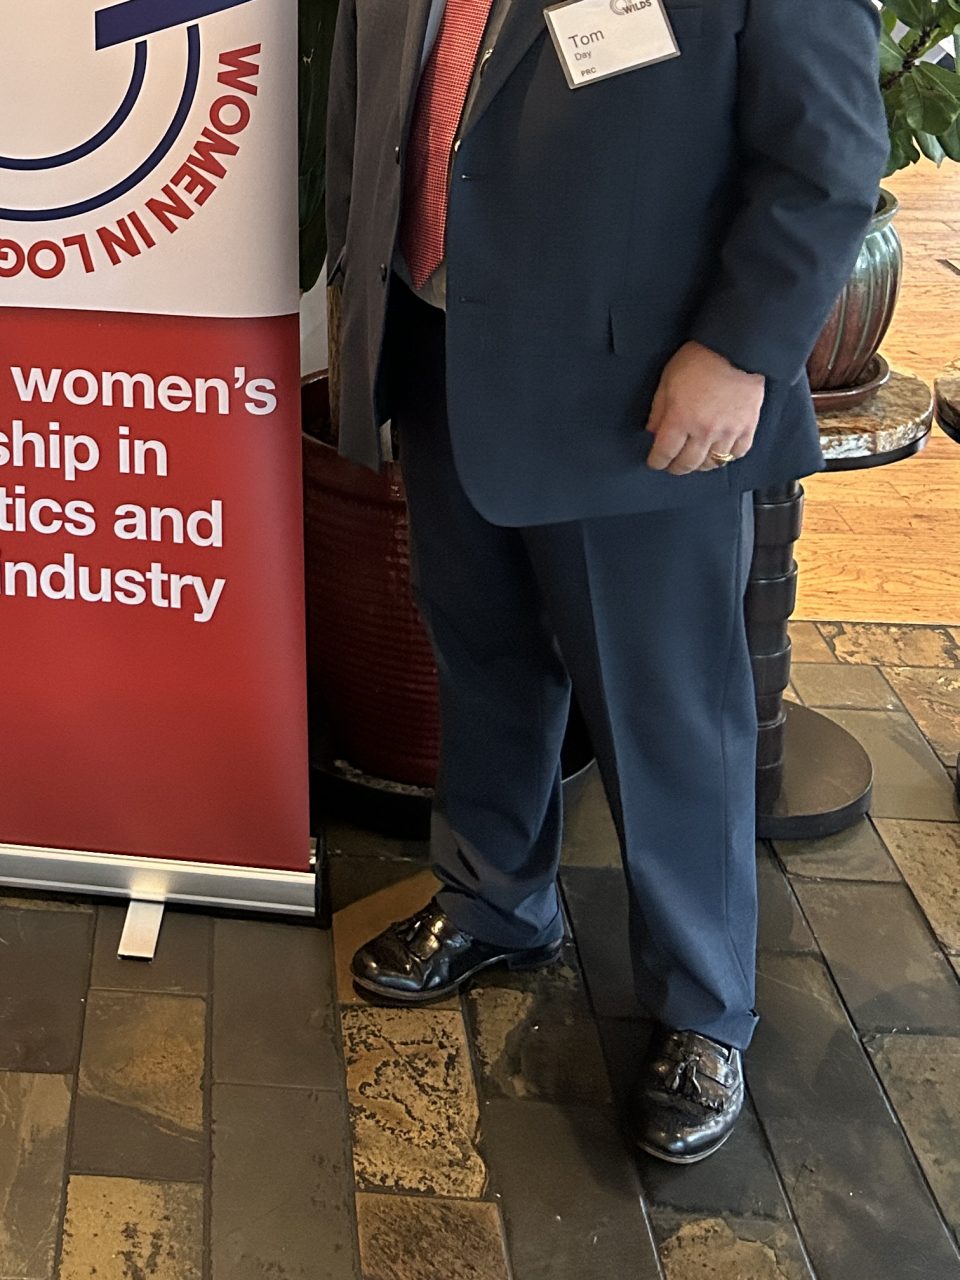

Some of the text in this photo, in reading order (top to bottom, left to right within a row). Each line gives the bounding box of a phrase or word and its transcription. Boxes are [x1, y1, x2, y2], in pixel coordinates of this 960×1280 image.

[568, 29, 605, 48] Tom
[574, 50, 592, 61] Day
[581, 67, 597, 77] PRC
[145, 43, 262, 235] WOMEN
[97, 210, 157, 266] IN
[10, 366, 278, 416] women's
[118, 426, 168, 477] in
[113, 500, 223, 548] and
